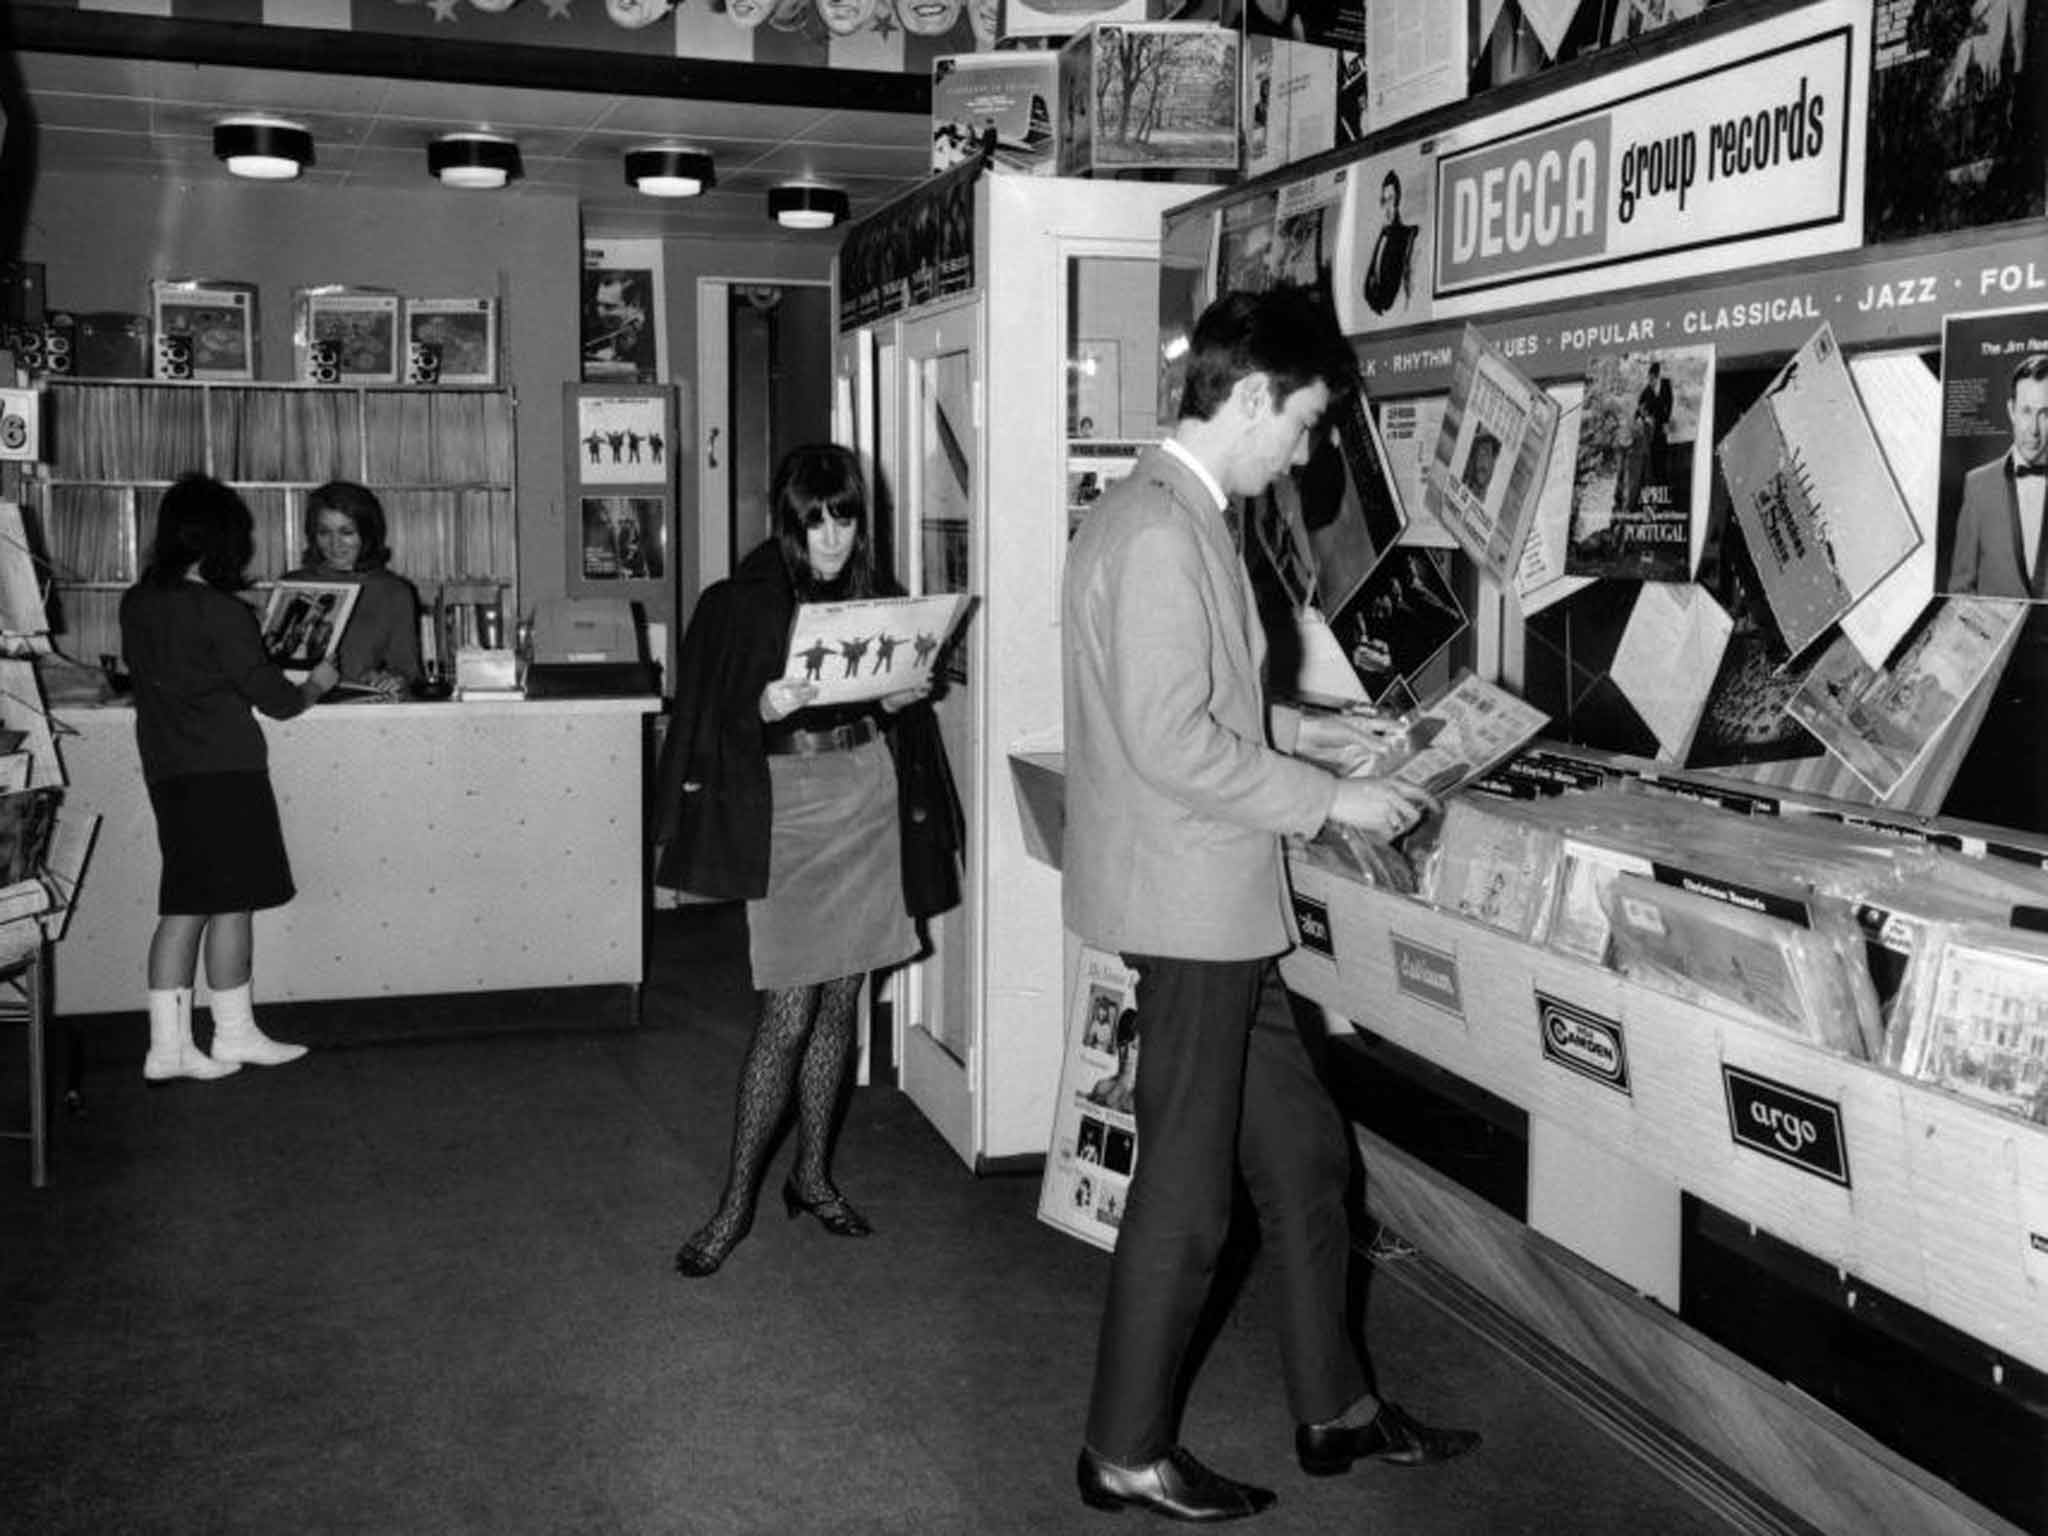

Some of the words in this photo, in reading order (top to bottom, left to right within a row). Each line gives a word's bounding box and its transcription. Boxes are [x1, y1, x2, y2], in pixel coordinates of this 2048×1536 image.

[1452, 139, 1598, 264] DECCA
[1618, 130, 1697, 223] group
[1708, 76, 1824, 182] records
[1393, 347, 1452, 374] RHYTHM
[1560, 318, 1655, 351] POPULAR
[1683, 294, 1821, 334] CLASSICAL
[1857, 276, 1938, 312] JAZZ
[1980, 263, 2047, 296] FOL
[1623, 524, 1688, 542] PORTUGAL
[1549, 1017, 1613, 1061] CAMDEN
[1751, 1101, 1817, 1151] argo
